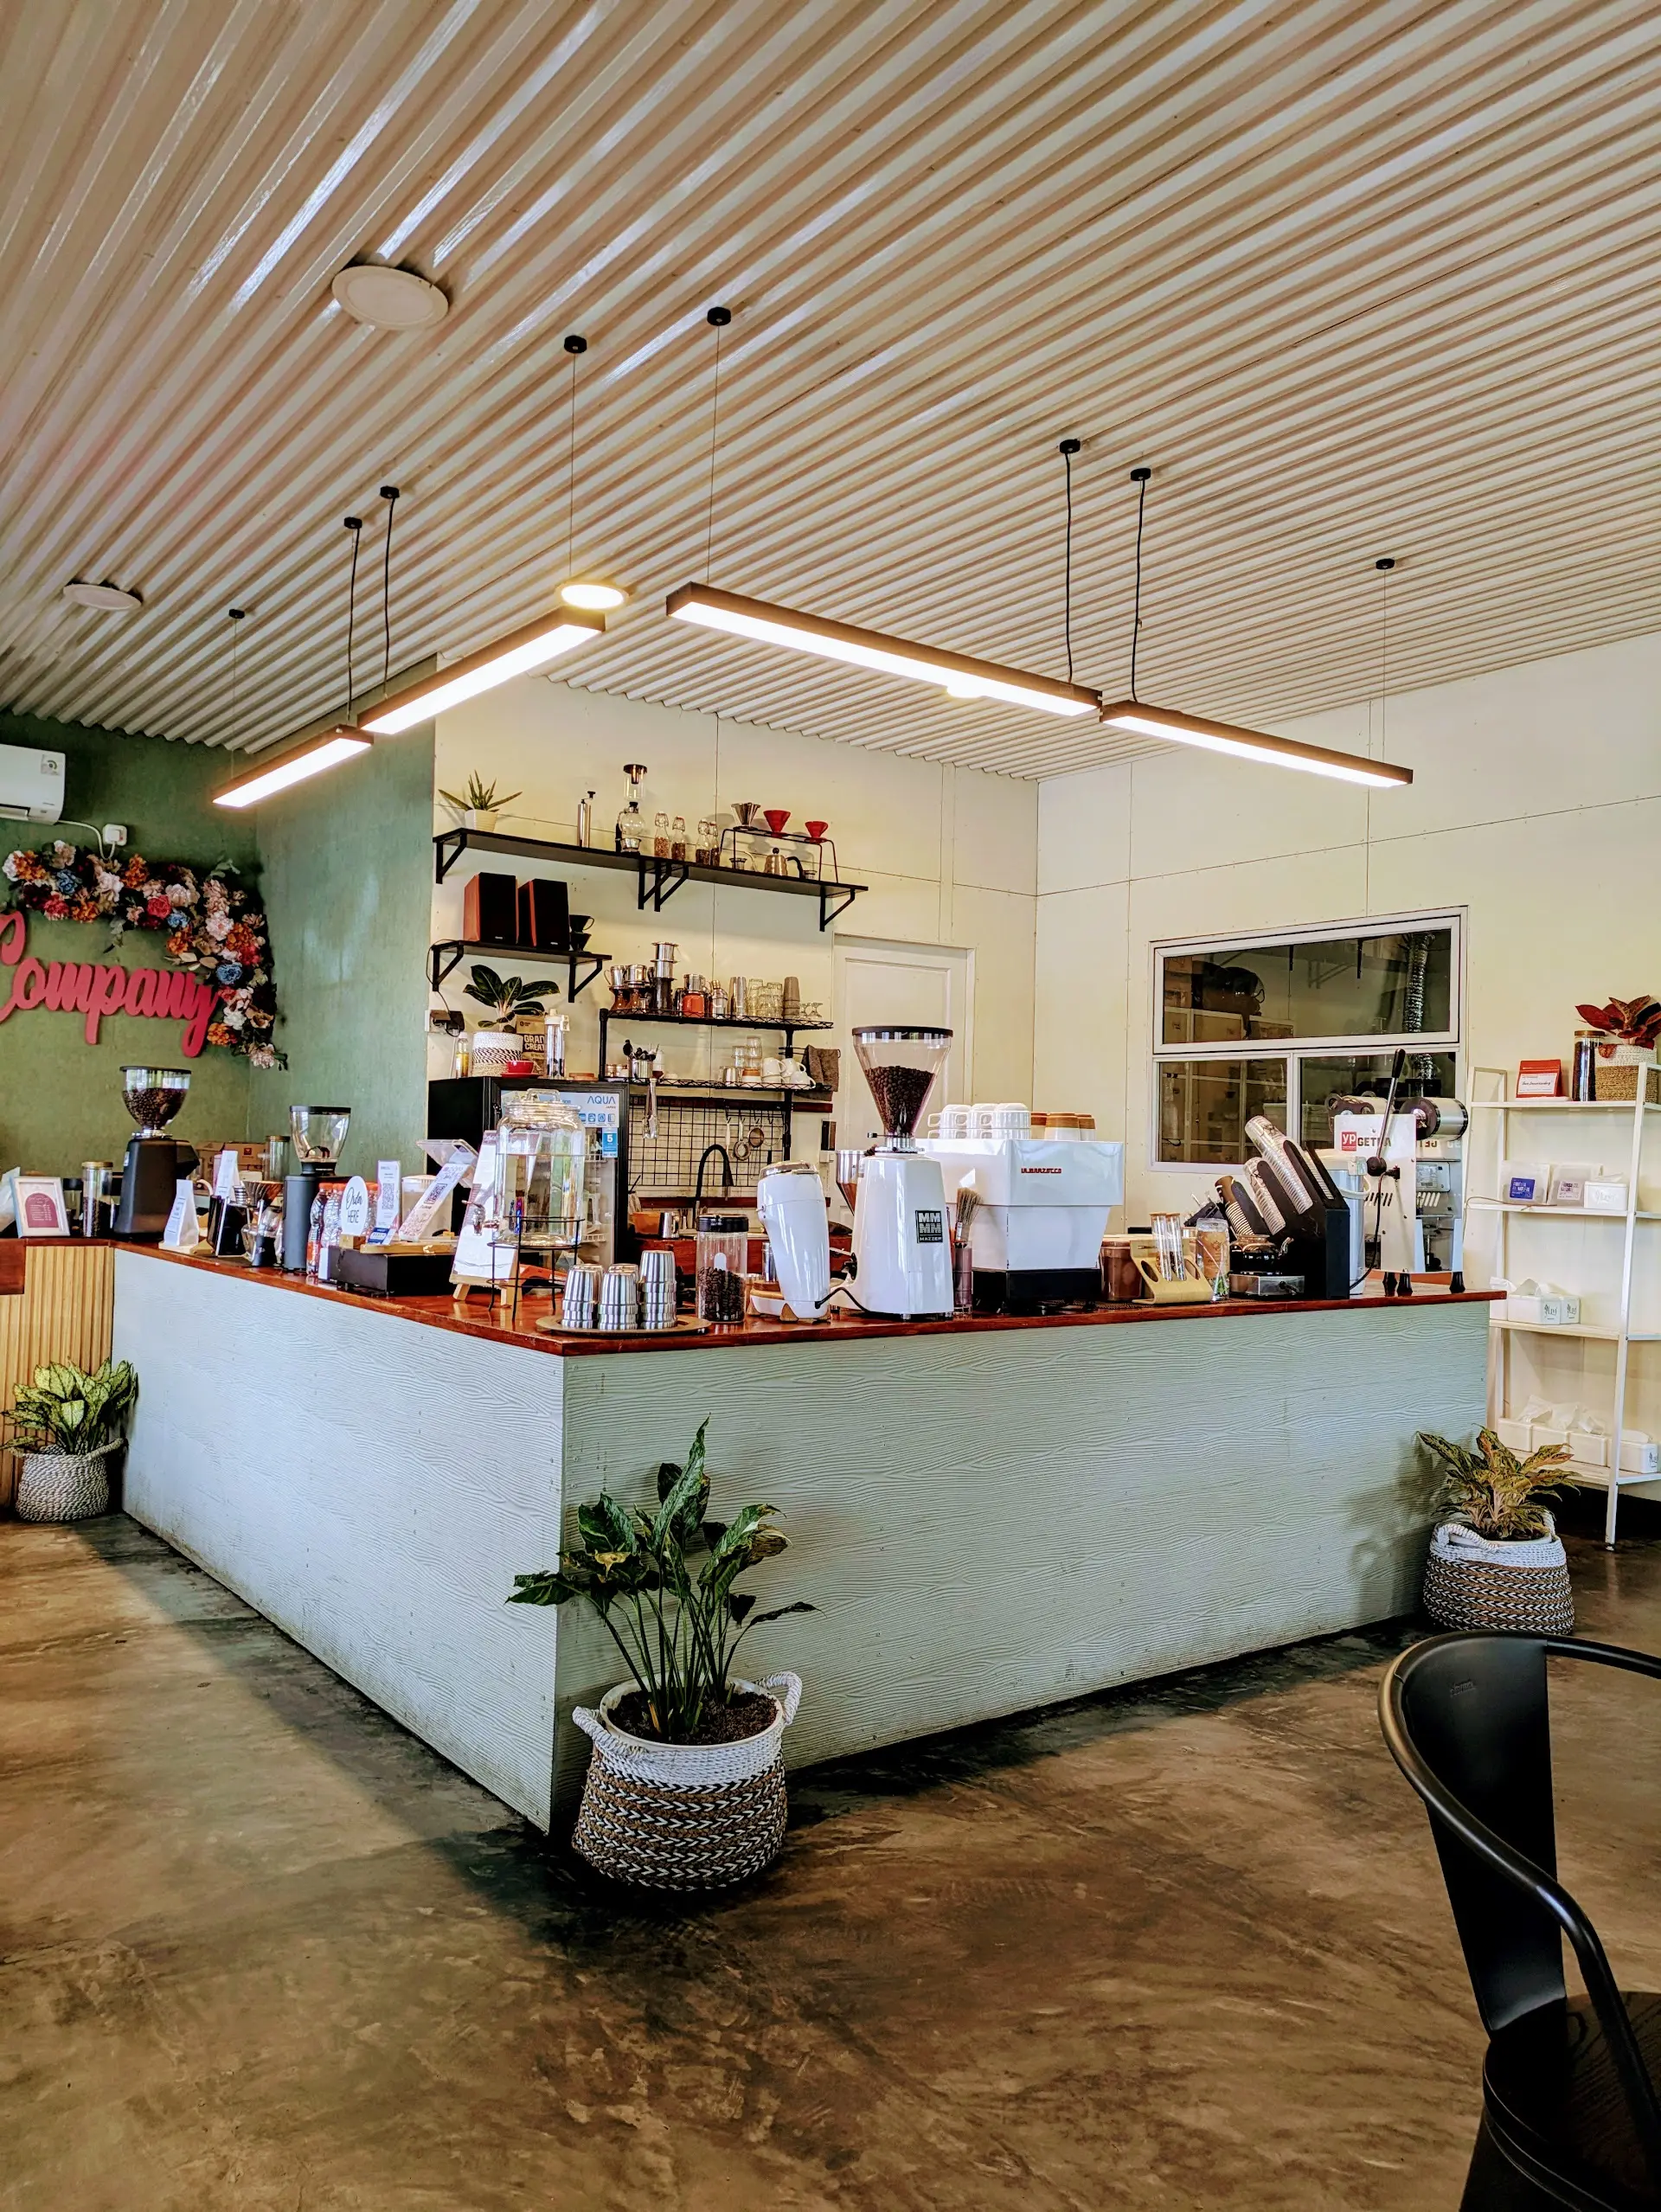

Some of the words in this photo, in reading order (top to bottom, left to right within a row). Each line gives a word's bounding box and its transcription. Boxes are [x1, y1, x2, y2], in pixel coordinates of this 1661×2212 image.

[587, 1095, 616, 1105] AQUA
[607, 1134, 613, 1143] 5
[346, 1187, 362, 1209] Order
[347, 1209, 360, 1223] HERE
